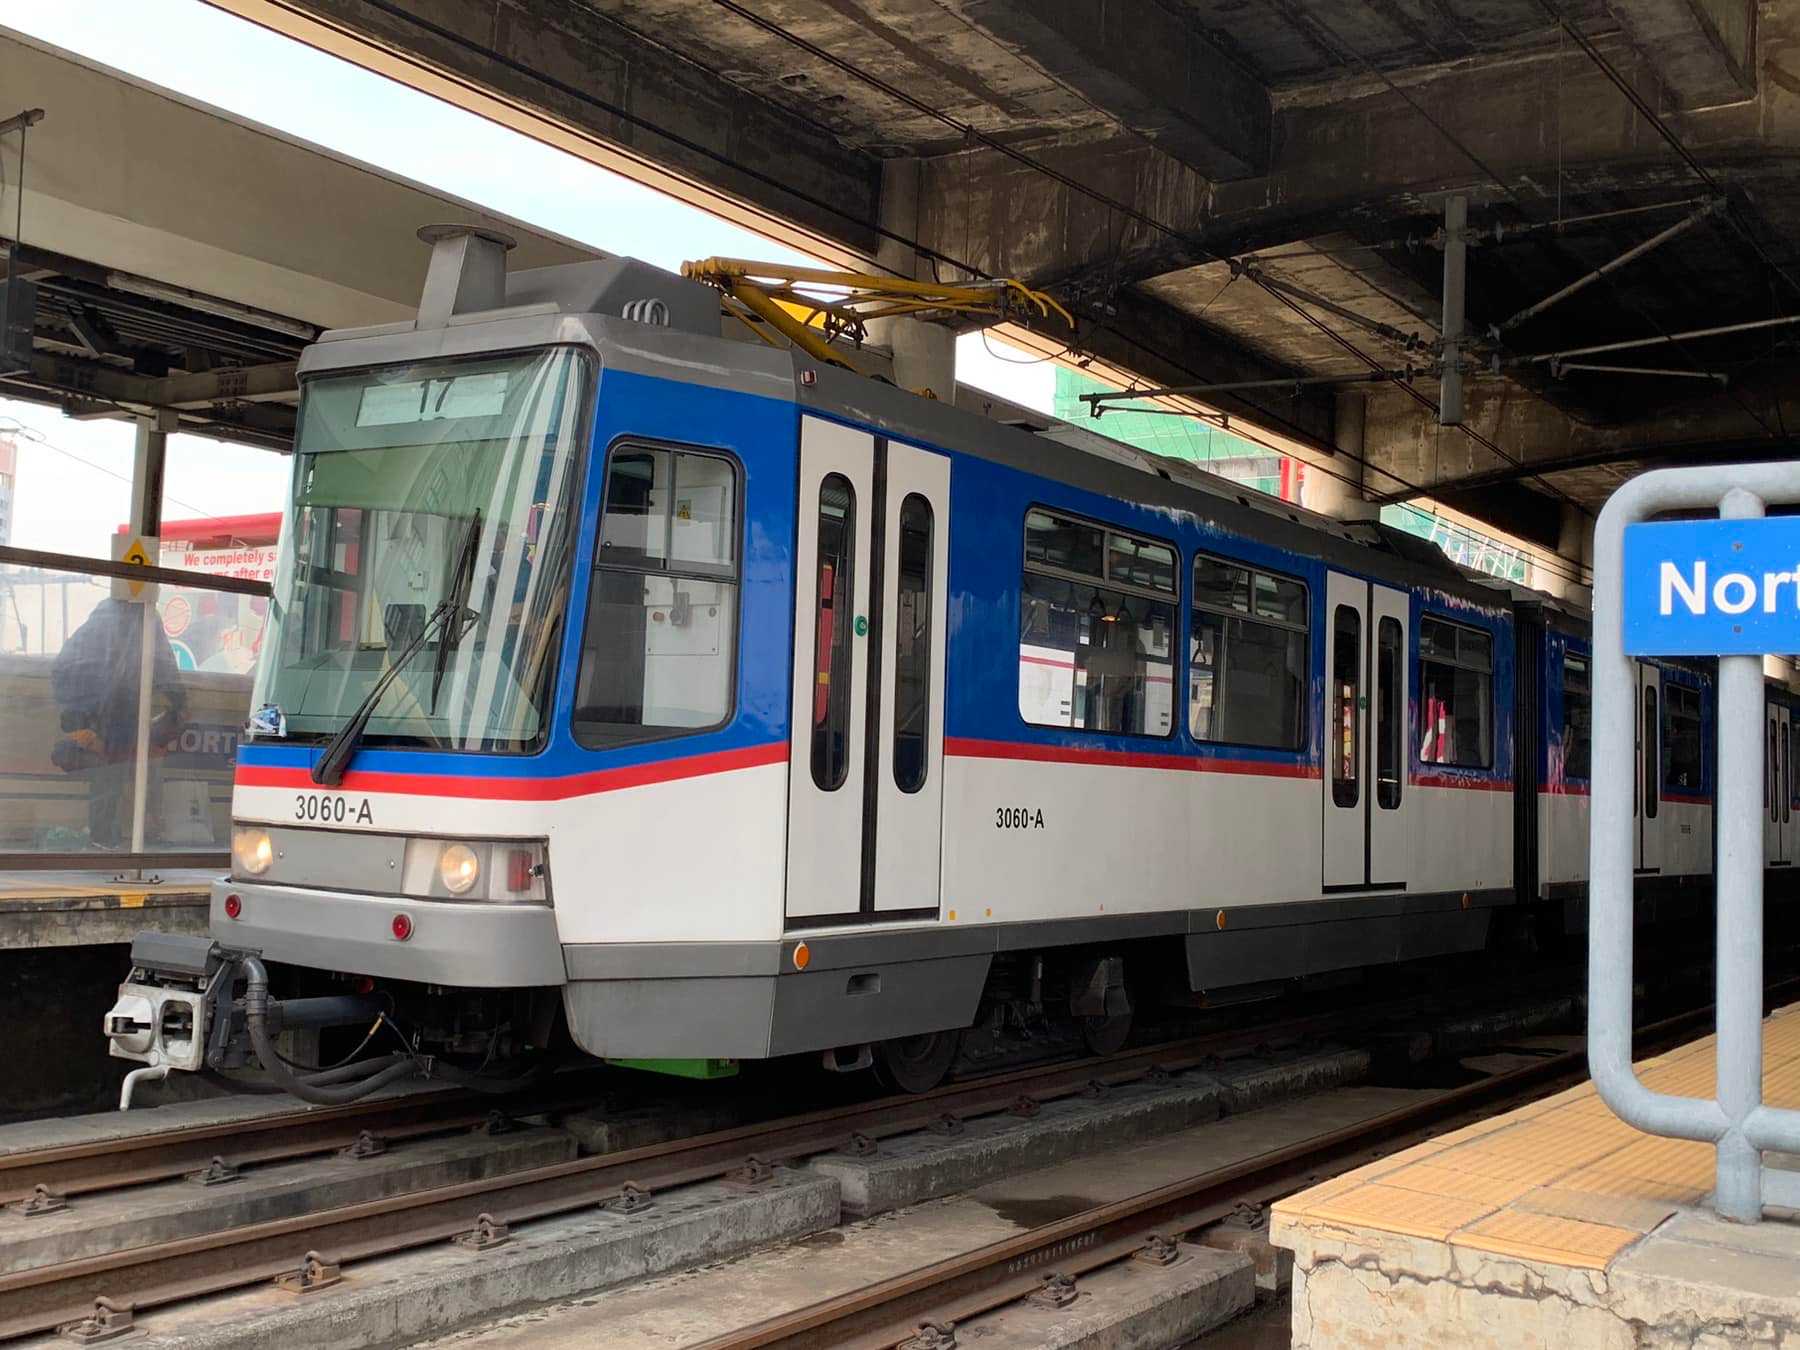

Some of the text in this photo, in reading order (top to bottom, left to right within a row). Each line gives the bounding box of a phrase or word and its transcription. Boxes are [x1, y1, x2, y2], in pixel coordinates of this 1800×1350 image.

[420, 378, 456, 414] 17
[184, 552, 200, 567] We
[203, 550, 264, 567] completely
[295, 795, 374, 825] 3060-A
[995, 807, 1045, 829] 3060-A
